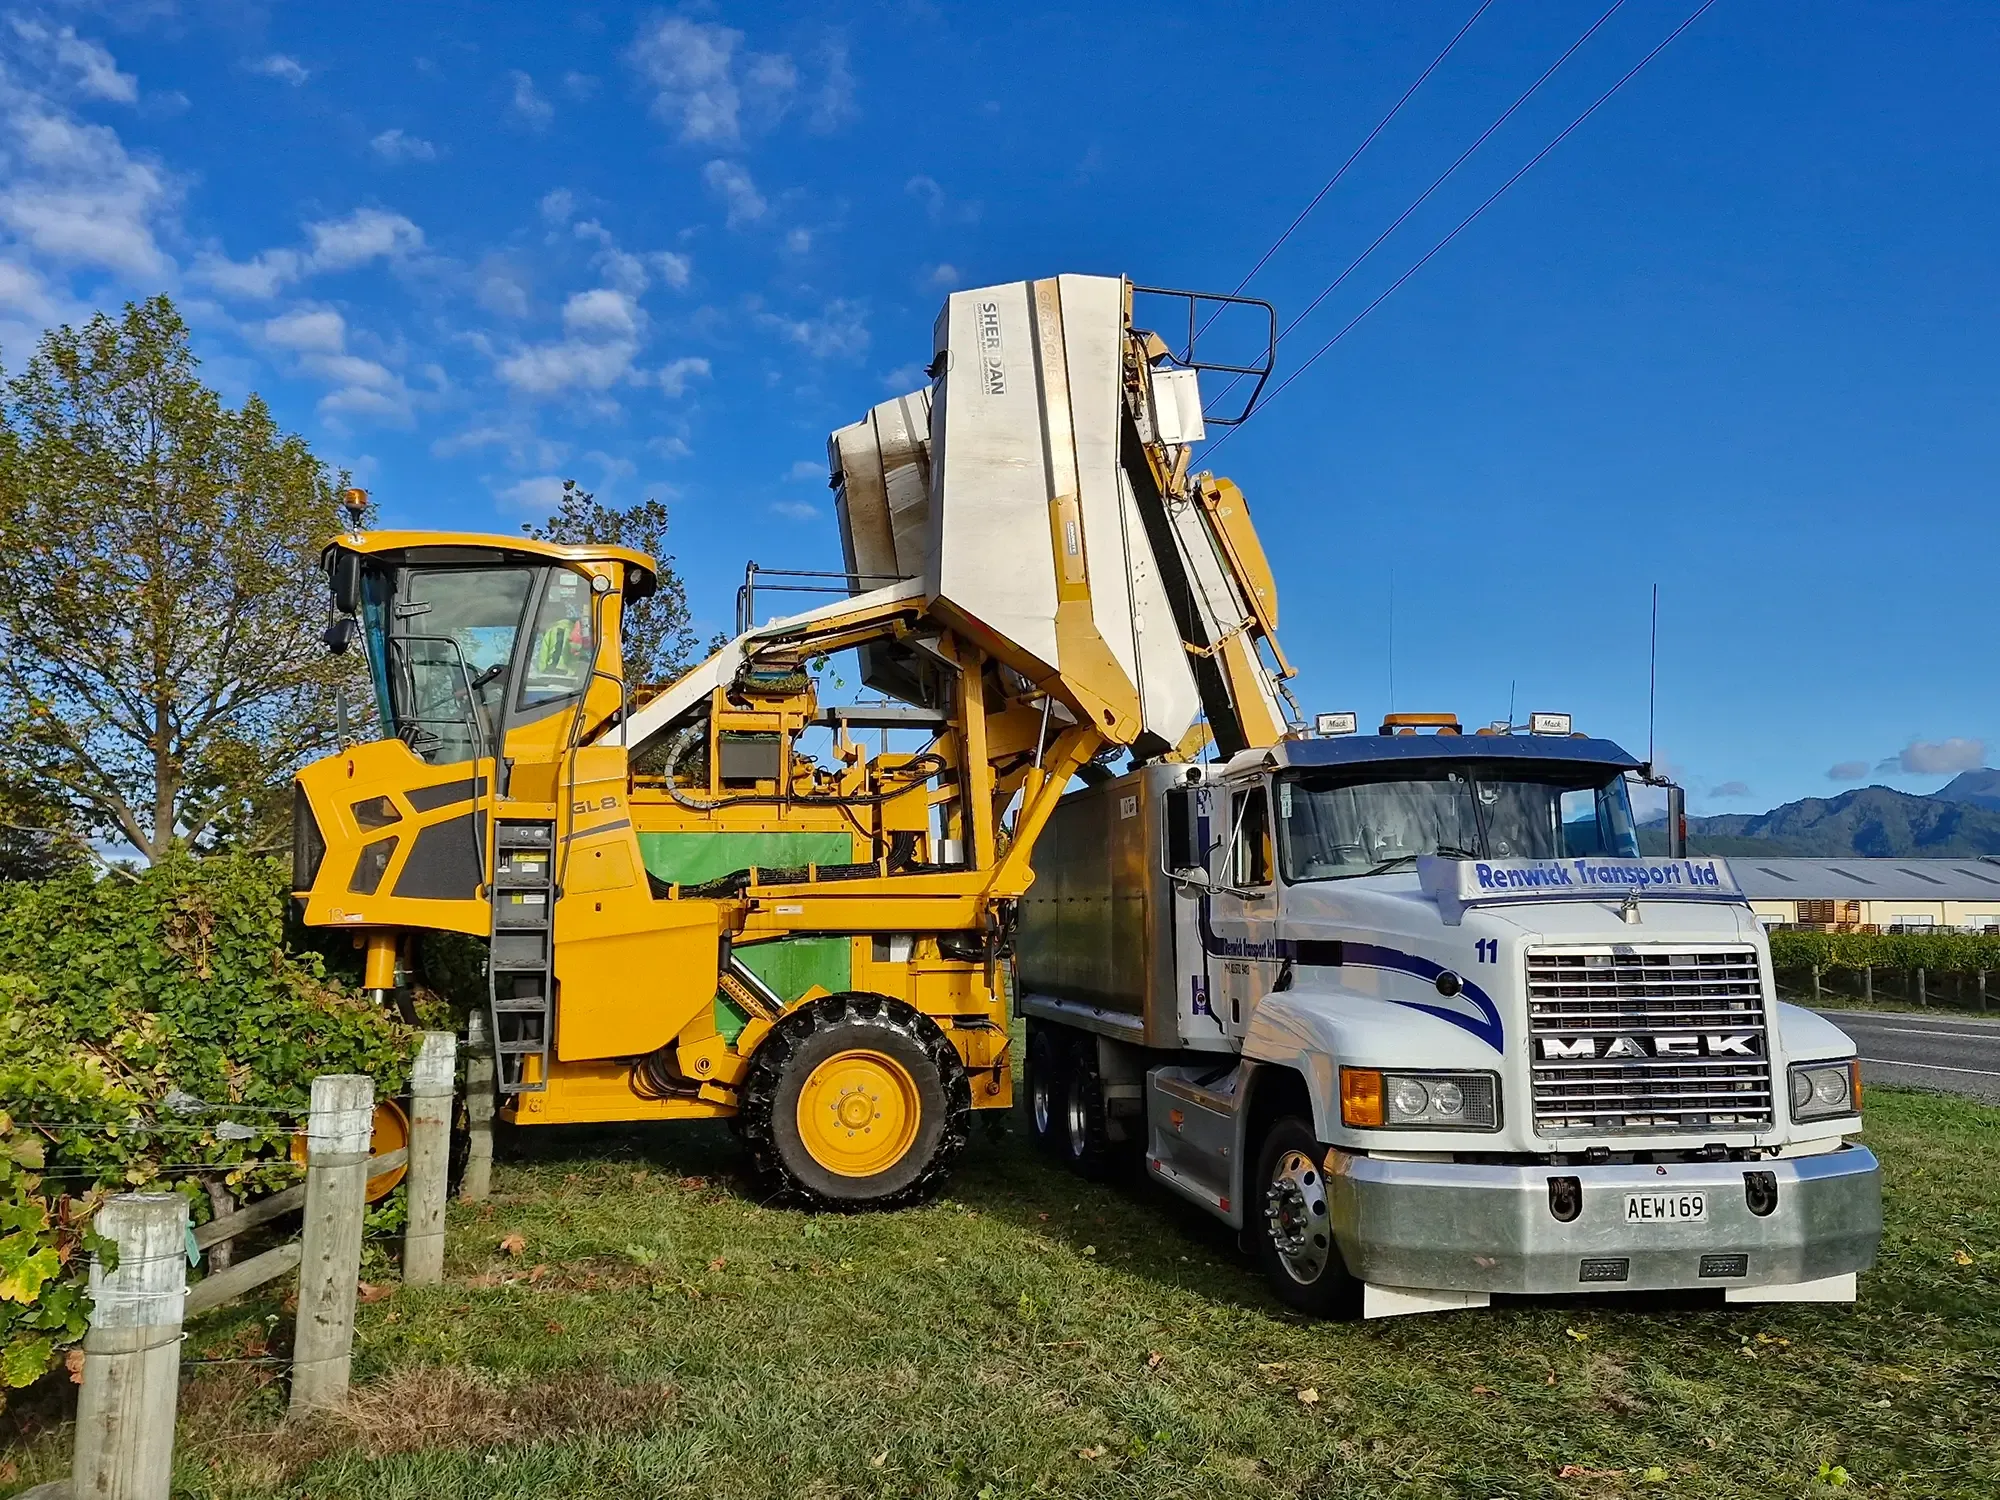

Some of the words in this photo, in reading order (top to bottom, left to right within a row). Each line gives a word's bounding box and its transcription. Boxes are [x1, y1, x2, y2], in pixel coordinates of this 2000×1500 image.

[977, 303, 986, 340] CONTRACTING
[983, 303, 1004, 395] SHERDAN
[981, 342, 990, 383] MARBOROUGH
[1328, 719, 1347, 728] Mack
[1543, 719, 1561, 728] Mack
[1476, 862, 1573, 888] Renwick
[1574, 860, 1680, 889] Transport
[1684, 860, 1719, 886] Ltd
[1475, 938, 1498, 964] 11
[1541, 1034, 1756, 1059] MACK
[1628, 1196, 1704, 1219] AEW169
